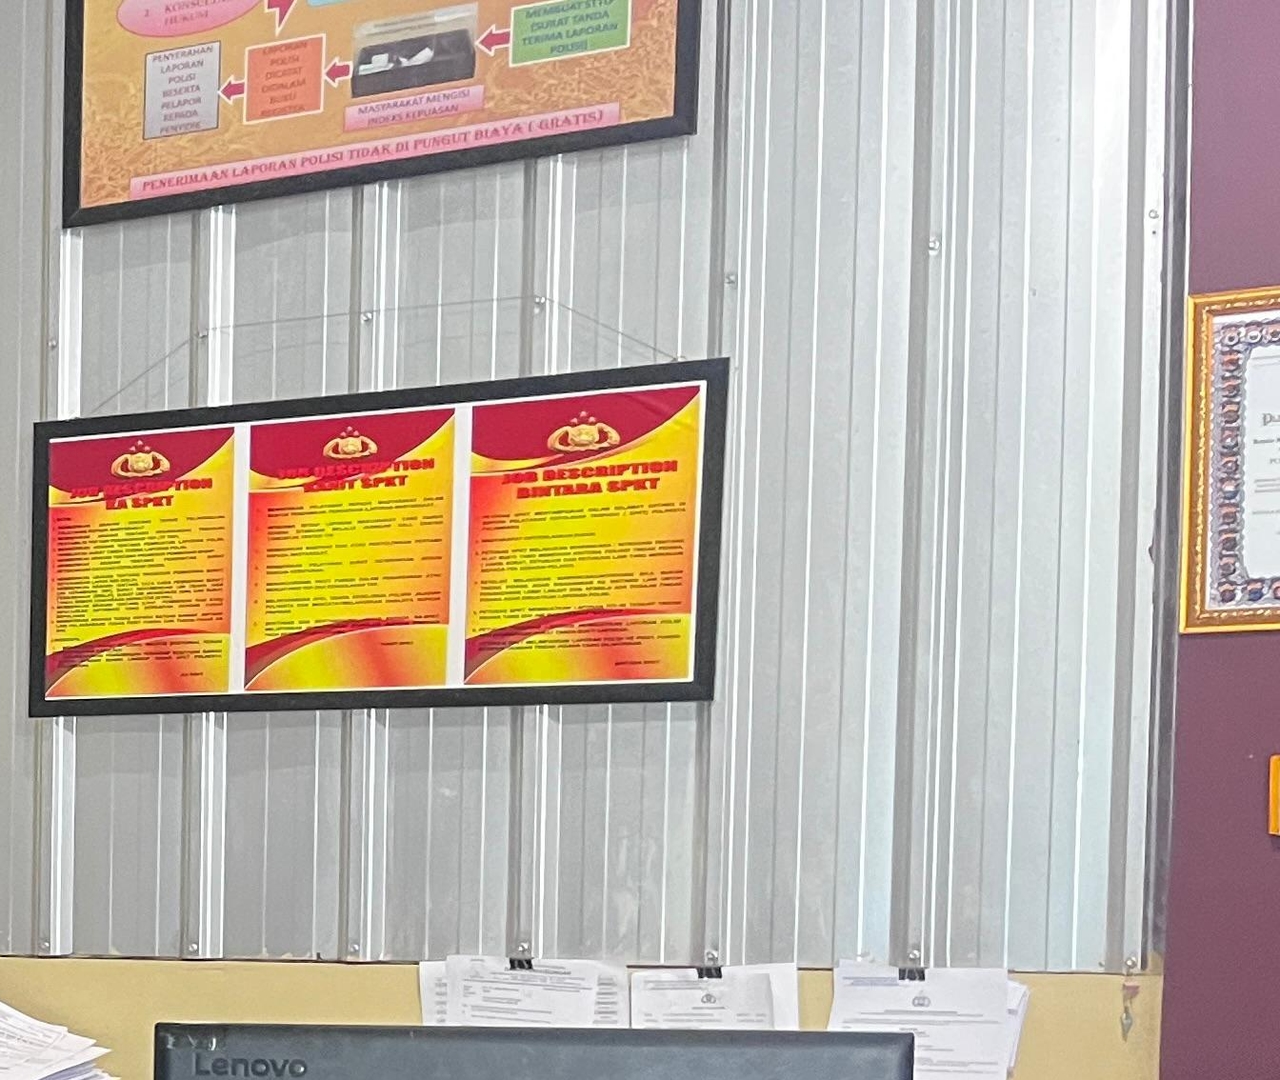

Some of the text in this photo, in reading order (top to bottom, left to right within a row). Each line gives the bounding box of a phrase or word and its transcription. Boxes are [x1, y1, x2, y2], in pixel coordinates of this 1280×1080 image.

[572, 10, 610, 26] TANDA
[358, 96, 425, 116] MASYARAKAT
[142, 170, 228, 191] PENERIMAAN
[233, 158, 296, 177] LAPORAN
[301, 151, 344, 168] POLISI
[349, 144, 390, 161] TIDAK
[395, 140, 410, 154] DI
[413, 131, 471, 150] PUNGUT
[474, 123, 523, 141] BIAYA
[543, 460, 678, 481] DESCRIPTION
[517, 478, 660, 499] BINTARA SPKT
[194, 1052, 308, 1077] Lenovo
